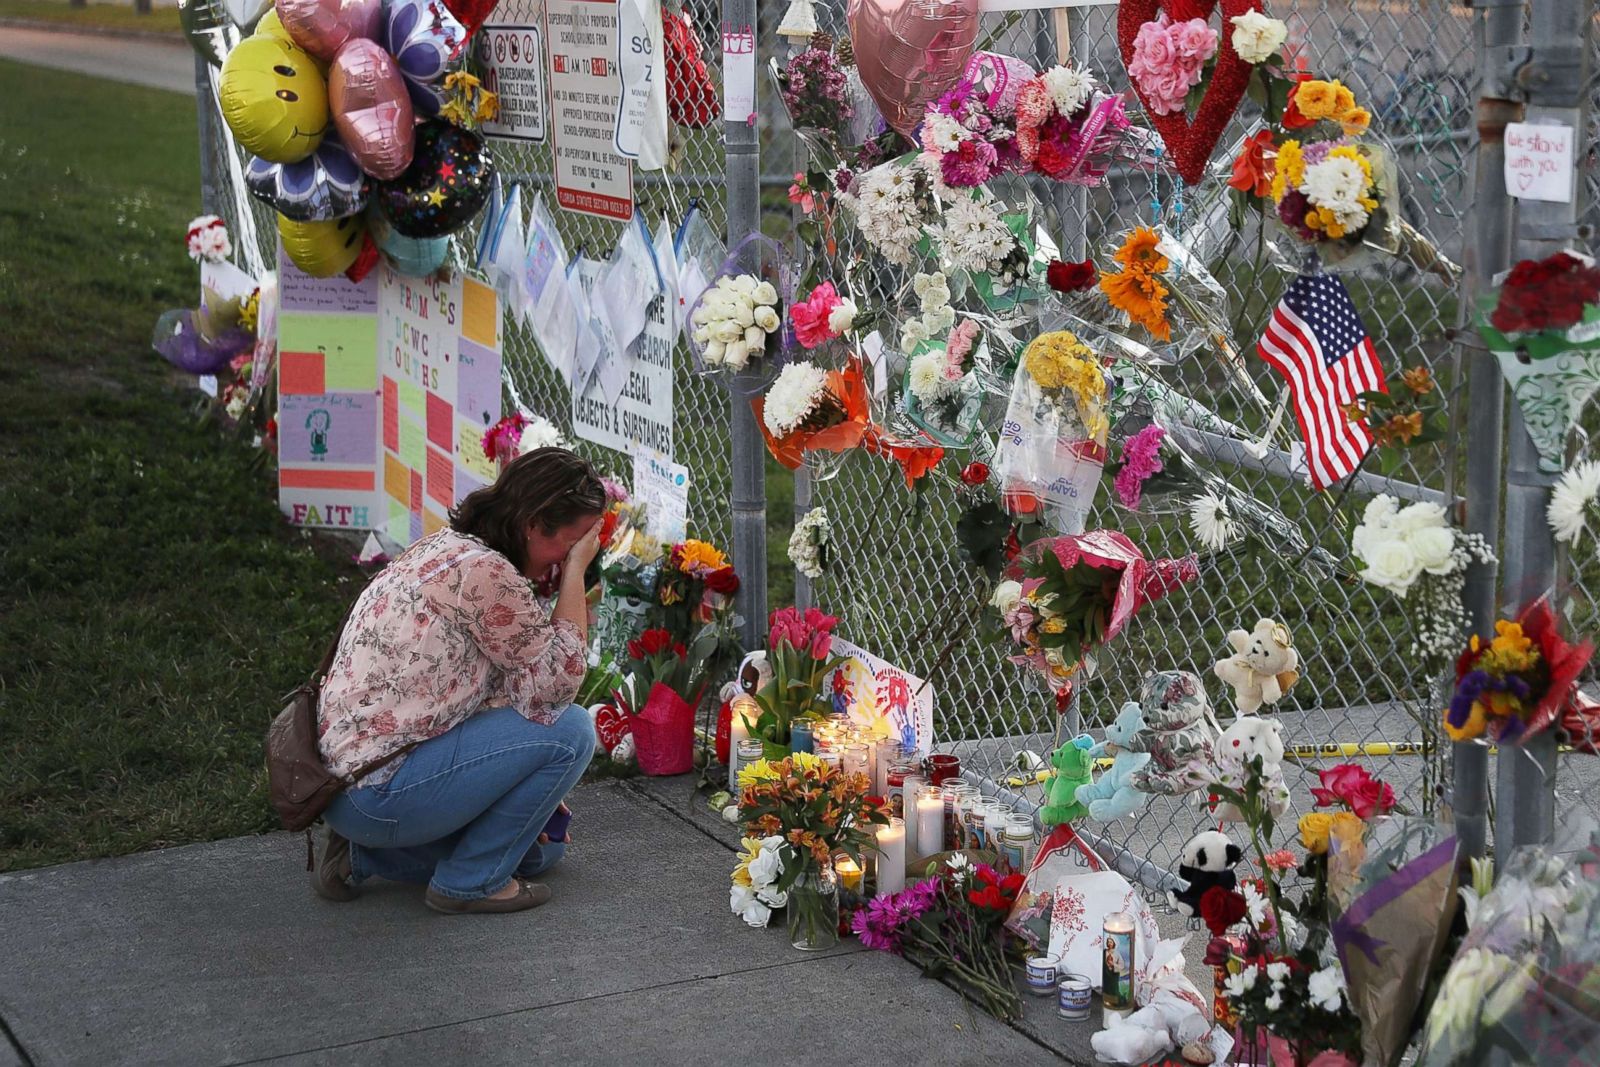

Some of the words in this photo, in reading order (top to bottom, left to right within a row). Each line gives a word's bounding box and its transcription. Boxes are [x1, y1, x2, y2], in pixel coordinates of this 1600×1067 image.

[499, 66, 535, 81] SKATEBOARDING
[583, 59, 591, 74] TO
[636, 332, 671, 371] SEARCH
[574, 396, 610, 433] OBJECTS
[612, 406, 619, 435] &
[622, 409, 671, 456] SUBSTANCES
[291, 504, 369, 526] FAITH
